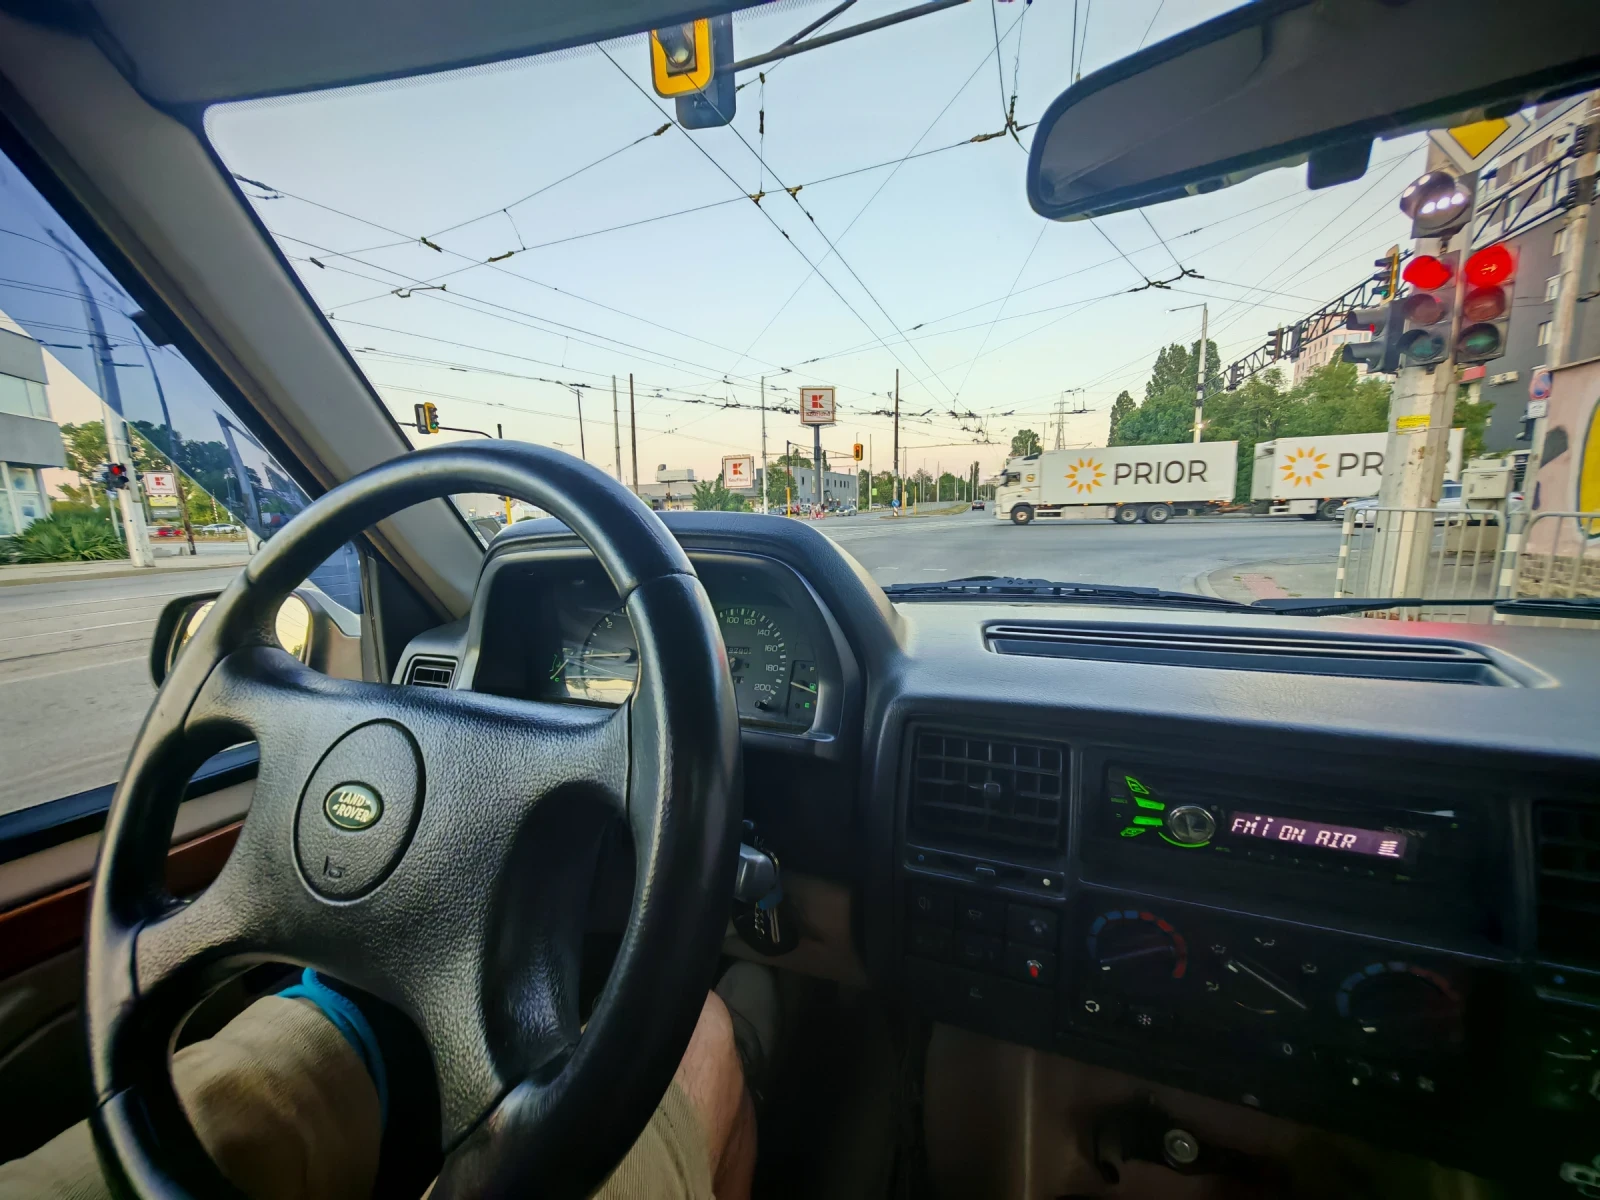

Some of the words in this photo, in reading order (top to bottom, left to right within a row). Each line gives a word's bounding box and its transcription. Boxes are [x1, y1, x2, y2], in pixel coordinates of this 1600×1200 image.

[1114, 460, 1208, 485] PRIOR
[754, 683, 771, 691] 200
[338, 791, 366, 806] LAND
[336, 804, 370, 822] ROVER
[1278, 825, 1307, 842] ON
[1315, 830, 1358, 849] AIR
